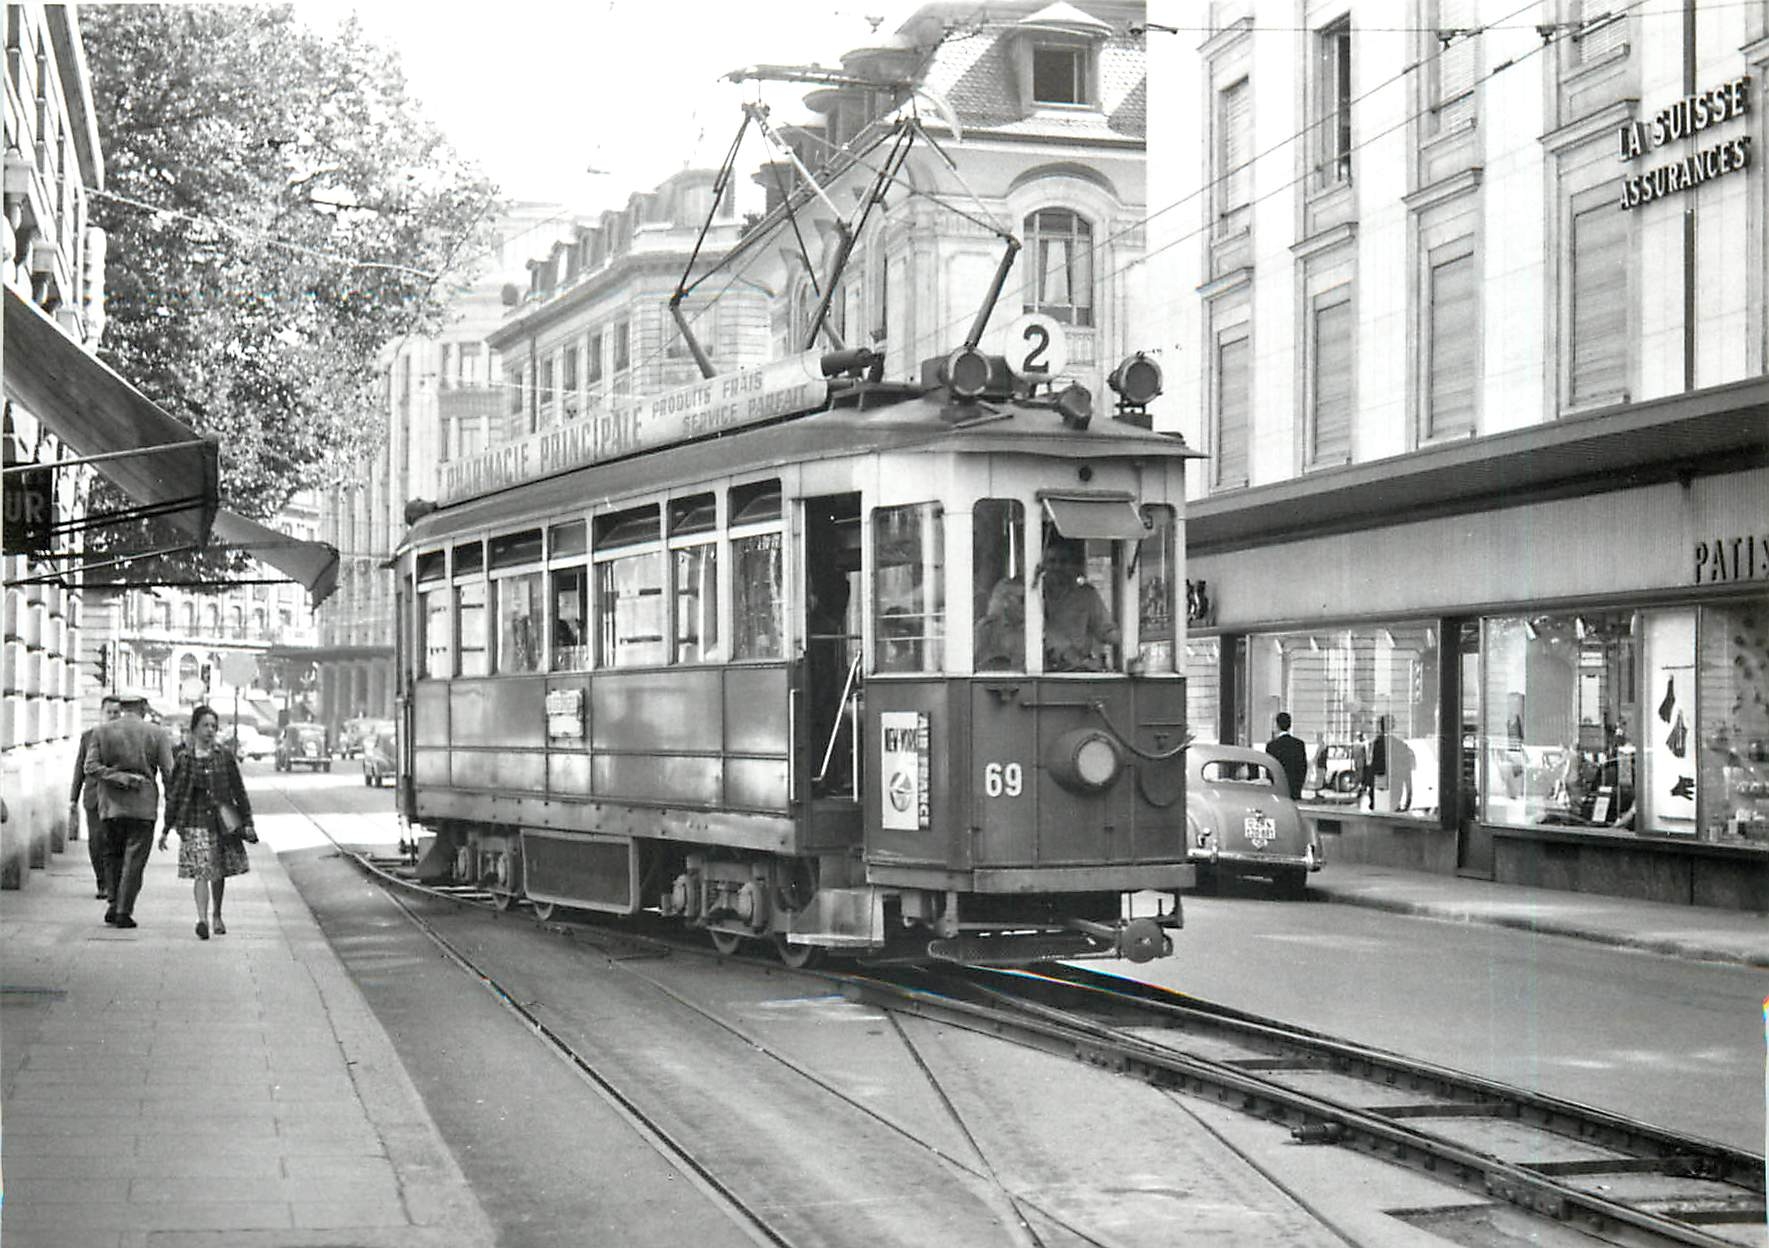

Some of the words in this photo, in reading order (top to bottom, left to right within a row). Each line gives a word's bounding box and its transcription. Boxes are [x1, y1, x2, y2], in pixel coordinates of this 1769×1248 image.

[1618, 120, 1647, 163] LA
[1654, 77, 1749, 147] SUISSE
[1619, 137, 1749, 209] ASSURANCES
[1023, 324, 1050, 374] 2
[651, 386, 712, 419] PRODUITS
[722, 371, 763, 399] FRAIS
[682, 403, 739, 434] SERVICE
[748, 385, 808, 418] PARFAIT
[447, 443, 529, 500] PHARMACIE
[540, 405, 642, 474] PRINCIPALE
[985, 762, 1023, 798] 69
